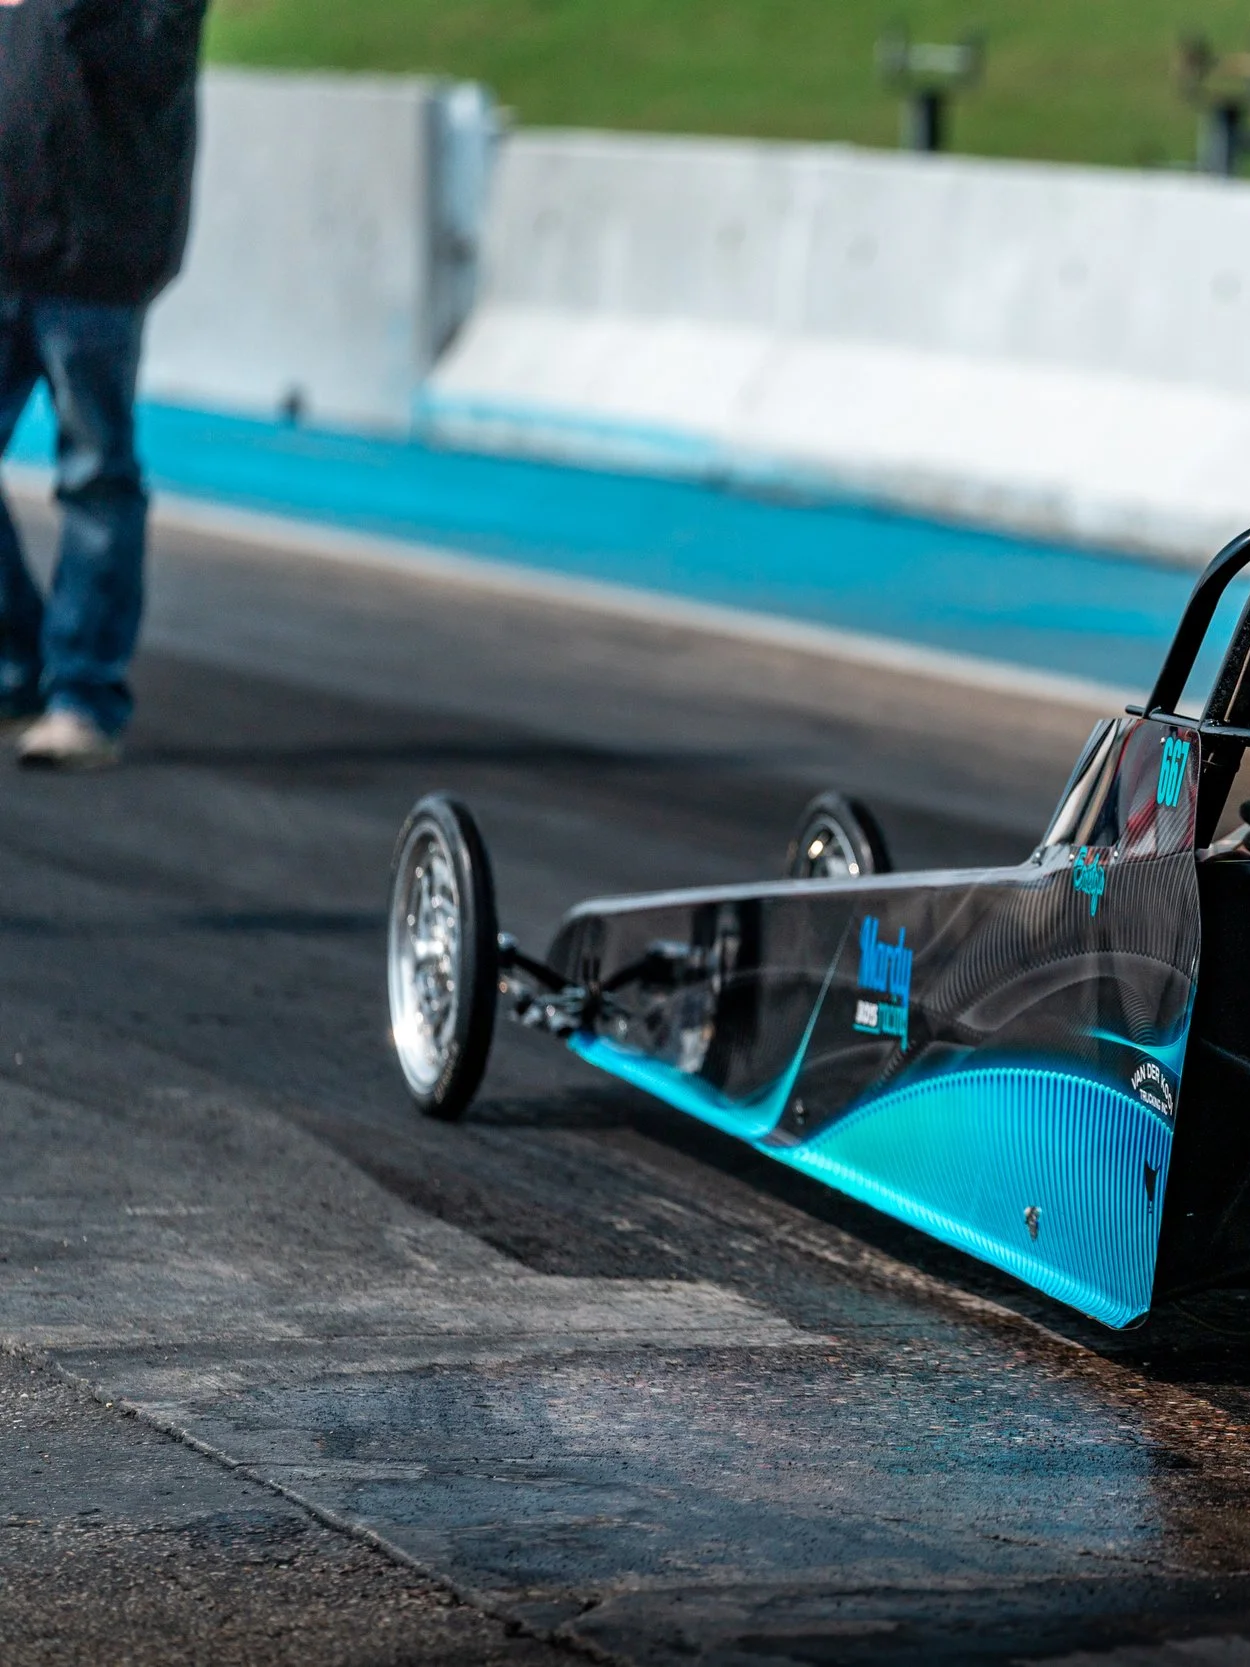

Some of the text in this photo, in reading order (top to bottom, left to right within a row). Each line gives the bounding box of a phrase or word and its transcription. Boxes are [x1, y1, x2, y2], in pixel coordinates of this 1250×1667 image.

[1157, 736, 1190, 808] 667
[1131, 1064, 1146, 1090] VAN
[1147, 1063, 1160, 1084] DER
